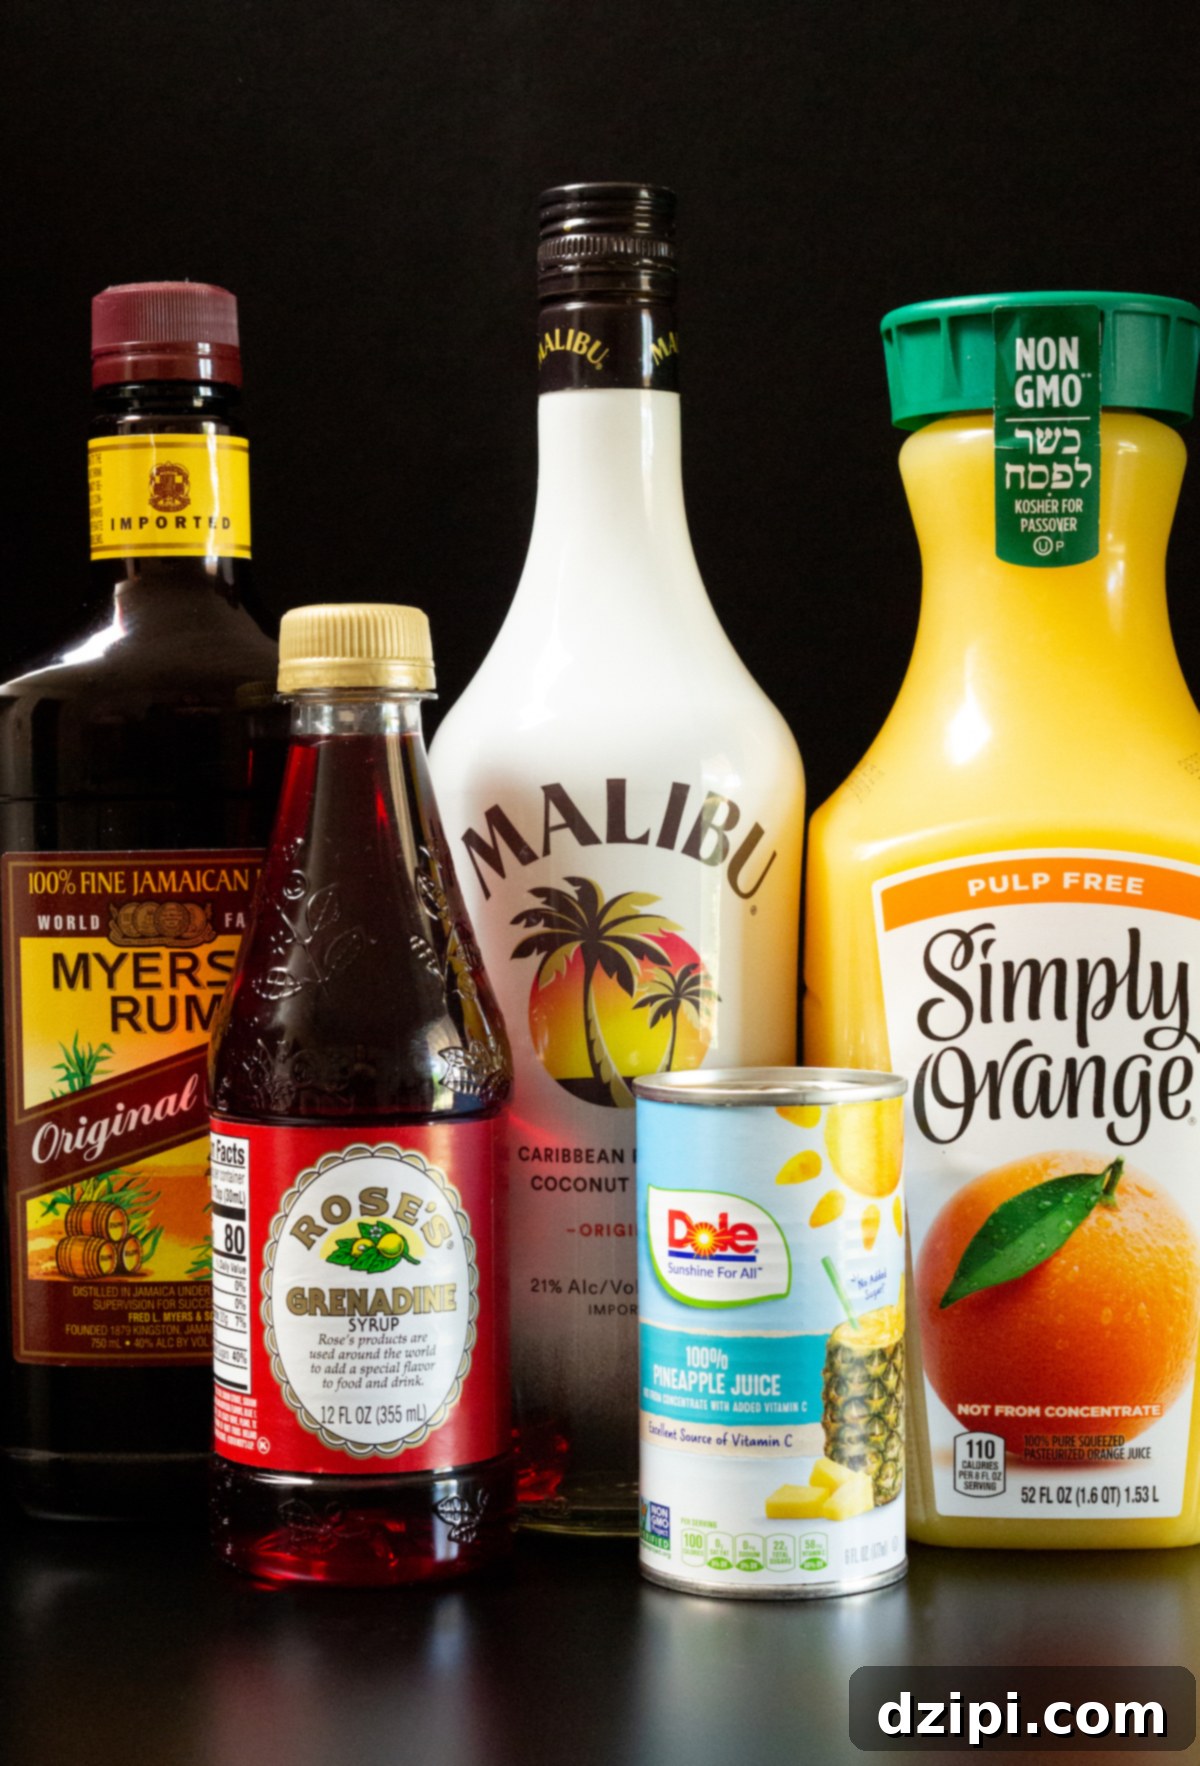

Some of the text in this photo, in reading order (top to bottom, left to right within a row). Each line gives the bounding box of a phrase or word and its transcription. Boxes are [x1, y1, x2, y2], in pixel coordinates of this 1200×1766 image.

[1015, 337, 1080, 371] NON
[1015, 373, 1083, 409] GMO
[1015, 427, 1081, 455] כשר
[1005, 456, 1093, 490] לפסח
[1015, 498, 1083, 514] KOSHER FOR
[111, 516, 231, 531] IMPORTED
[1020, 517, 1078, 532] PASSOVER
[461, 778, 777, 900] MALIBU
[28, 869, 76, 895] 100%
[80, 871, 127, 894] FINE
[132, 869, 249, 896] JAMAICAN
[967, 871, 1145, 897] PULP FREE
[37, 915, 100, 931] WORLD
[52, 950, 236, 991] MYERS
[917, 923, 1200, 1054] Simply
[913, 1039, 1194, 1146] Orange
[31, 1073, 199, 1164] Original
[216, 1139, 246, 1165] Facts
[518, 1146, 625, 1164] CARIBBEAN
[531, 1175, 630, 1193] COCONUT
[290, 1187, 453, 1250] ROSE'S
[224, 1223, 246, 1255] 80
[668, 1209, 758, 1256] Dole
[668, 1262, 714, 1278] Sunshine
[717, 1266, 738, 1279] For
[73, 1285, 211, 1297] DISTILLED IN JAMAICA UNDER
[530, 1278, 562, 1294] 21%
[93, 1299, 155, 1310] SUPERVISION
[157, 1299, 176, 1310] FOR
[285, 1283, 457, 1317] GRENADINE
[128, 1312, 150, 1323] FRED
[163, 1311, 193, 1322] MYERS
[196, 1311, 202, 1321] &
[348, 1317, 400, 1332] SYRUP
[65, 1325, 108, 1336] FOUNDED
[91, 1338, 107, 1348] 750
[156, 1337, 175, 1348] ALC
[176, 1337, 188, 1348] BY
[318, 1334, 428, 1349] Rose's products are
[309, 1345, 437, 1360] used around the world
[685, 1346, 729, 1370] 100%
[310, 1361, 436, 1378] to add a special flavor
[322, 1375, 425, 1392] to food and drink.
[653, 1363, 782, 1397] PINEAPPLE JUICE
[663, 1393, 708, 1411] CONCENTRATE
[710, 1400, 730, 1412] WITH
[733, 1401, 761, 1413] ADDED
[764, 1401, 799, 1413] VITAMIN
[801, 1401, 808, 1412] C
[957, 1404, 1161, 1418] NOT FROM CONCENTRATE
[321, 1404, 428, 1426] 12 FL OZ (355 mL)
[648, 1420, 793, 1448] Excellent Source of Vitamin C
[1024, 1435, 1125, 1447] 100% PURE SQUEEZED
[966, 1439, 996, 1459] 110
[1024, 1447, 1151, 1460] PASTEURIZED ORANGE JUICE
[961, 1461, 999, 1471] CALORIES
[959, 1471, 1003, 1481] PER 8 FL OZ
[963, 1481, 997, 1491] SERVING
[1021, 1485, 1160, 1507] 52 FL OZ (1.6 QT) 1.53 L
[684, 1533, 703, 1549] 100
